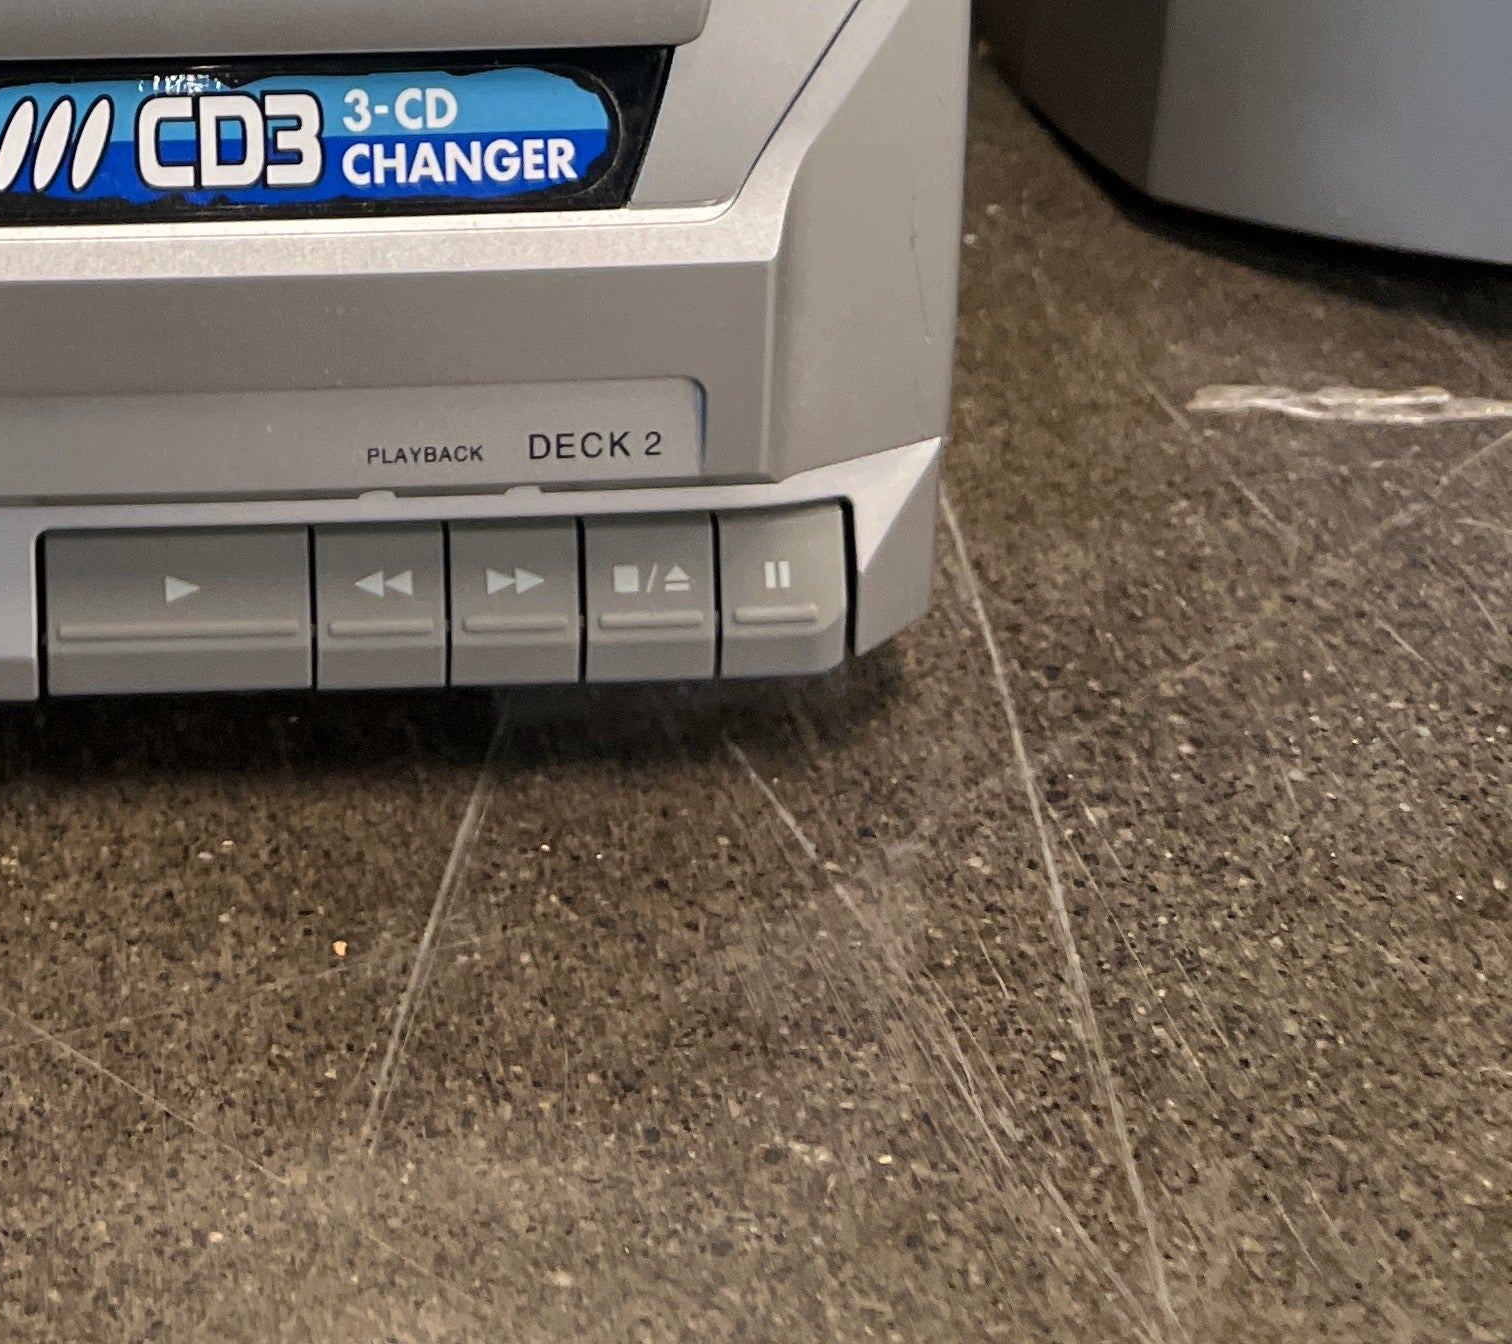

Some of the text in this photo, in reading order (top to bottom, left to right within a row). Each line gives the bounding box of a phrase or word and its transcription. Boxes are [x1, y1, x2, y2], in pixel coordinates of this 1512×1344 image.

[341, 86, 459, 133] 3-CD
[135, 89, 325, 190] CD3
[341, 136, 580, 186] CHANGER
[366, 443, 484, 466] PLAYBACK
[527, 430, 663, 461] DECK 2
